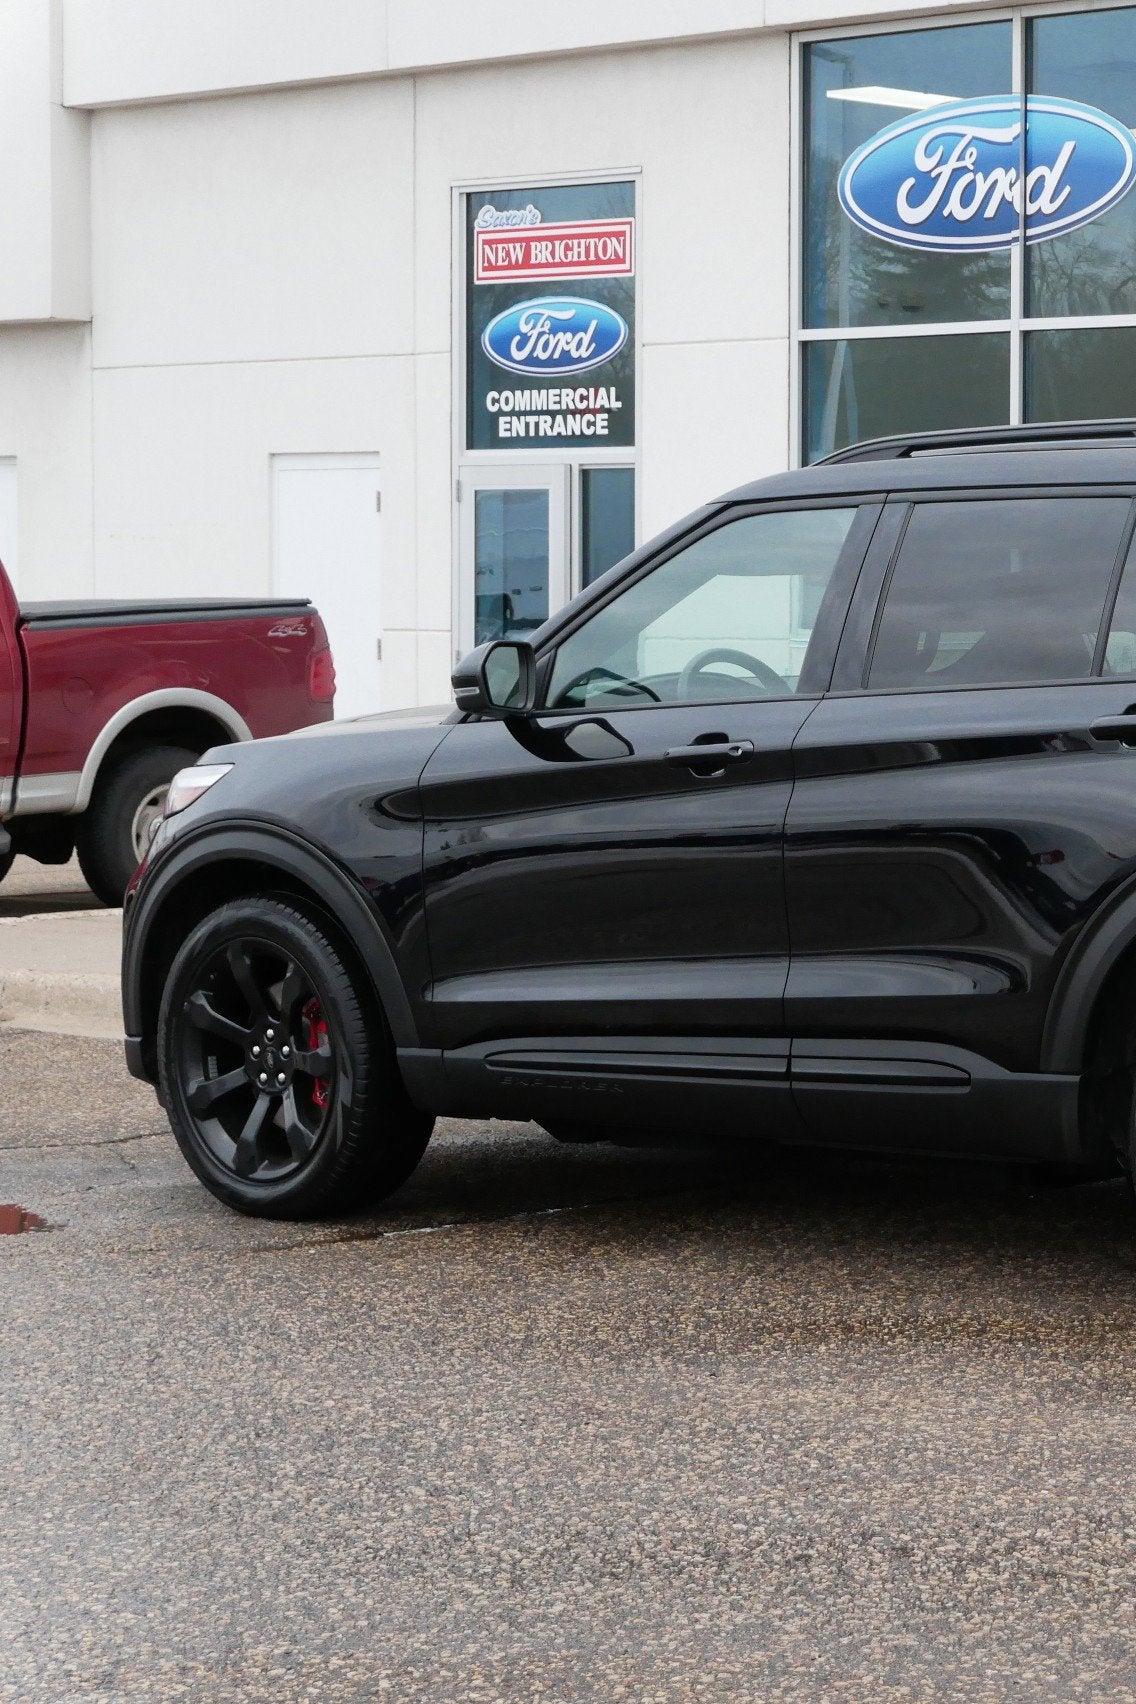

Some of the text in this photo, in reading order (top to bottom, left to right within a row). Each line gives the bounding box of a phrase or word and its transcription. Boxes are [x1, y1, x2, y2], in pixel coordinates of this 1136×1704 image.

[896, 121, 1077, 225] Ford
[483, 236, 625, 267] NEW BRIGHTON
[510, 307, 599, 361] Ford
[486, 386, 623, 413] COMMERCIAL
[498, 413, 609, 438] ENTRANCE
